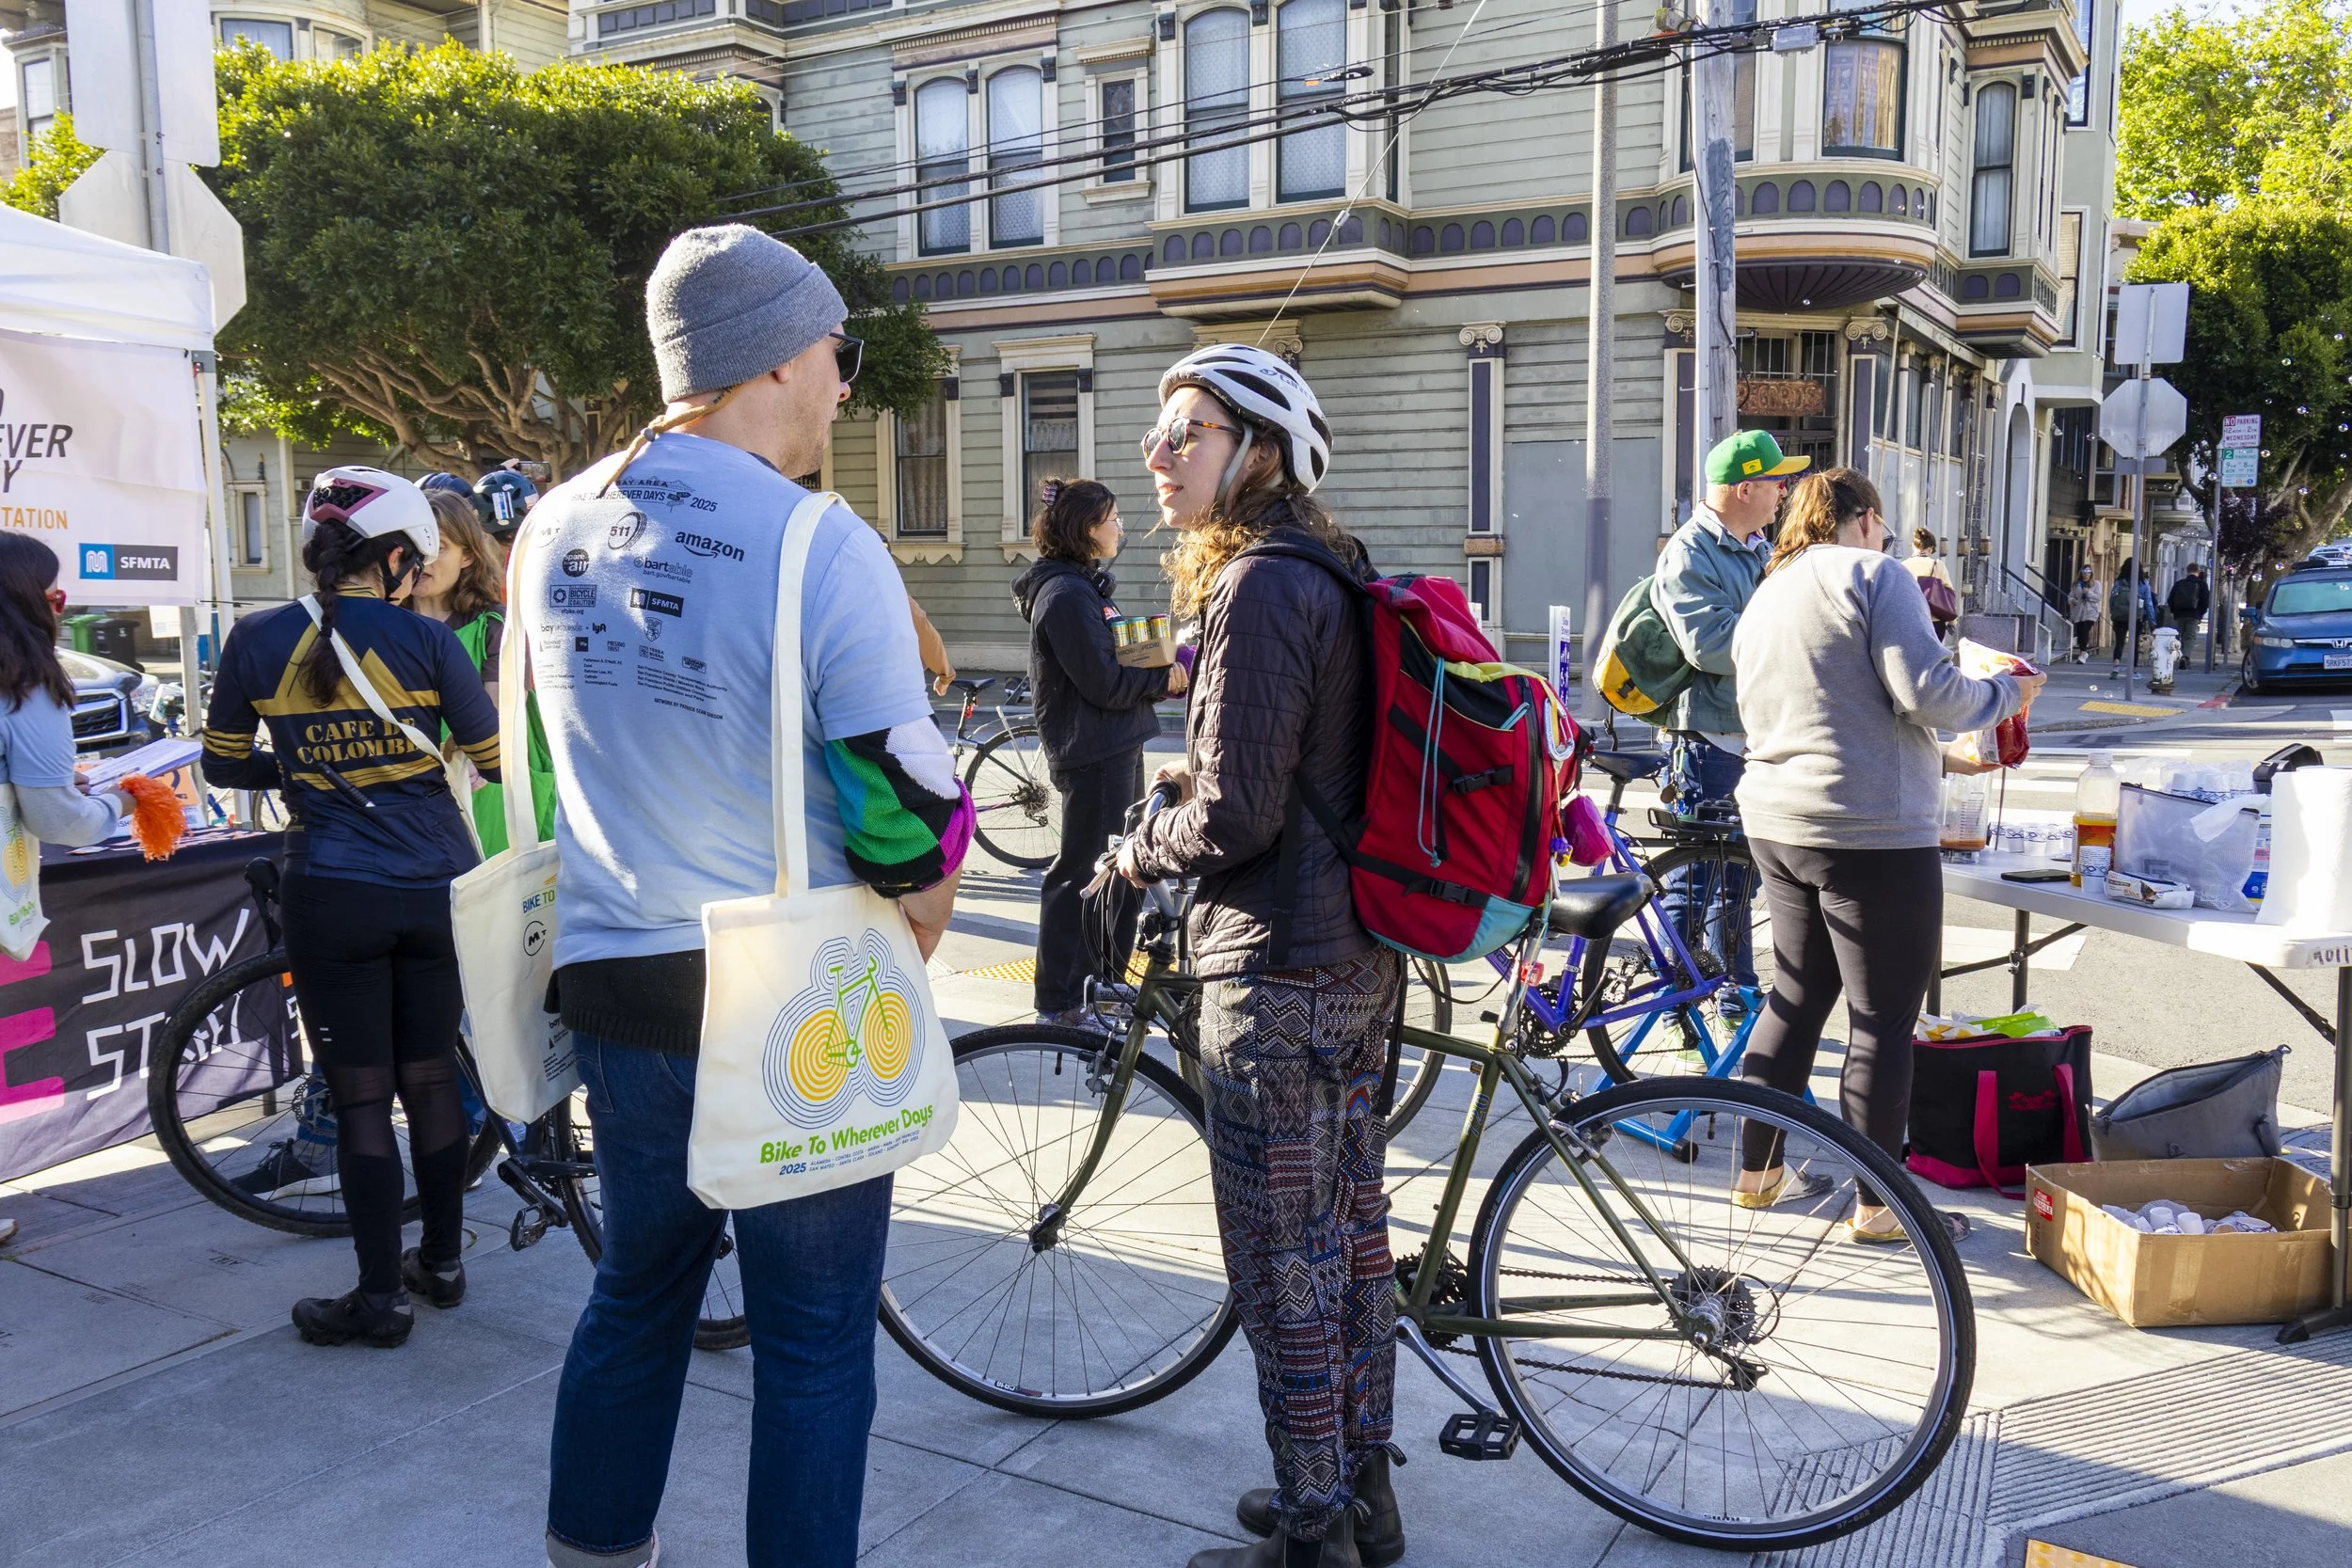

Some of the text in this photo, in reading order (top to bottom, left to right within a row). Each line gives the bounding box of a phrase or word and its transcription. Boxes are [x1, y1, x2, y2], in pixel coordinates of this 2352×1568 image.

[2225, 417, 2235, 426] NO
[0, 423, 72, 458] VER
[2225, 450, 2233, 459] 2
[643, 490, 666, 500] DAYS
[690, 498, 718, 512] 2025
[610, 526, 630, 537] 511
[675, 531, 745, 562] amazon
[120, 557, 170, 570] SFMTA
[644, 557, 692, 578] bartable
[643, 568, 691, 584] bart.gov/bartable
[570, 589, 595, 598] BICYCLE
[651, 596, 679, 610] SFMTA
[305, 720, 374, 743] CAFE
[523, 890, 555, 913] BIKE TO
[80, 908, 250, 1005] SLOW
[1463, 1092, 1491, 1138] 720
[759, 1104, 934, 1164] Bike To Wherever Days
[810, 1158, 832, 1166] ALAMEDA
[834, 1152, 851, 1162] CONTRA
[851, 1149, 865, 1158] COSTA
[819, 1163, 834, 1171] MATEO
[838, 1158, 852, 1166] SANTA
[852, 1154, 866, 1163] CLARA
[867, 1148, 883, 1158] SOLANO
[778, 1162, 806, 1176] 2025
[1478, 1203, 1499, 1256] SCHWALBE
